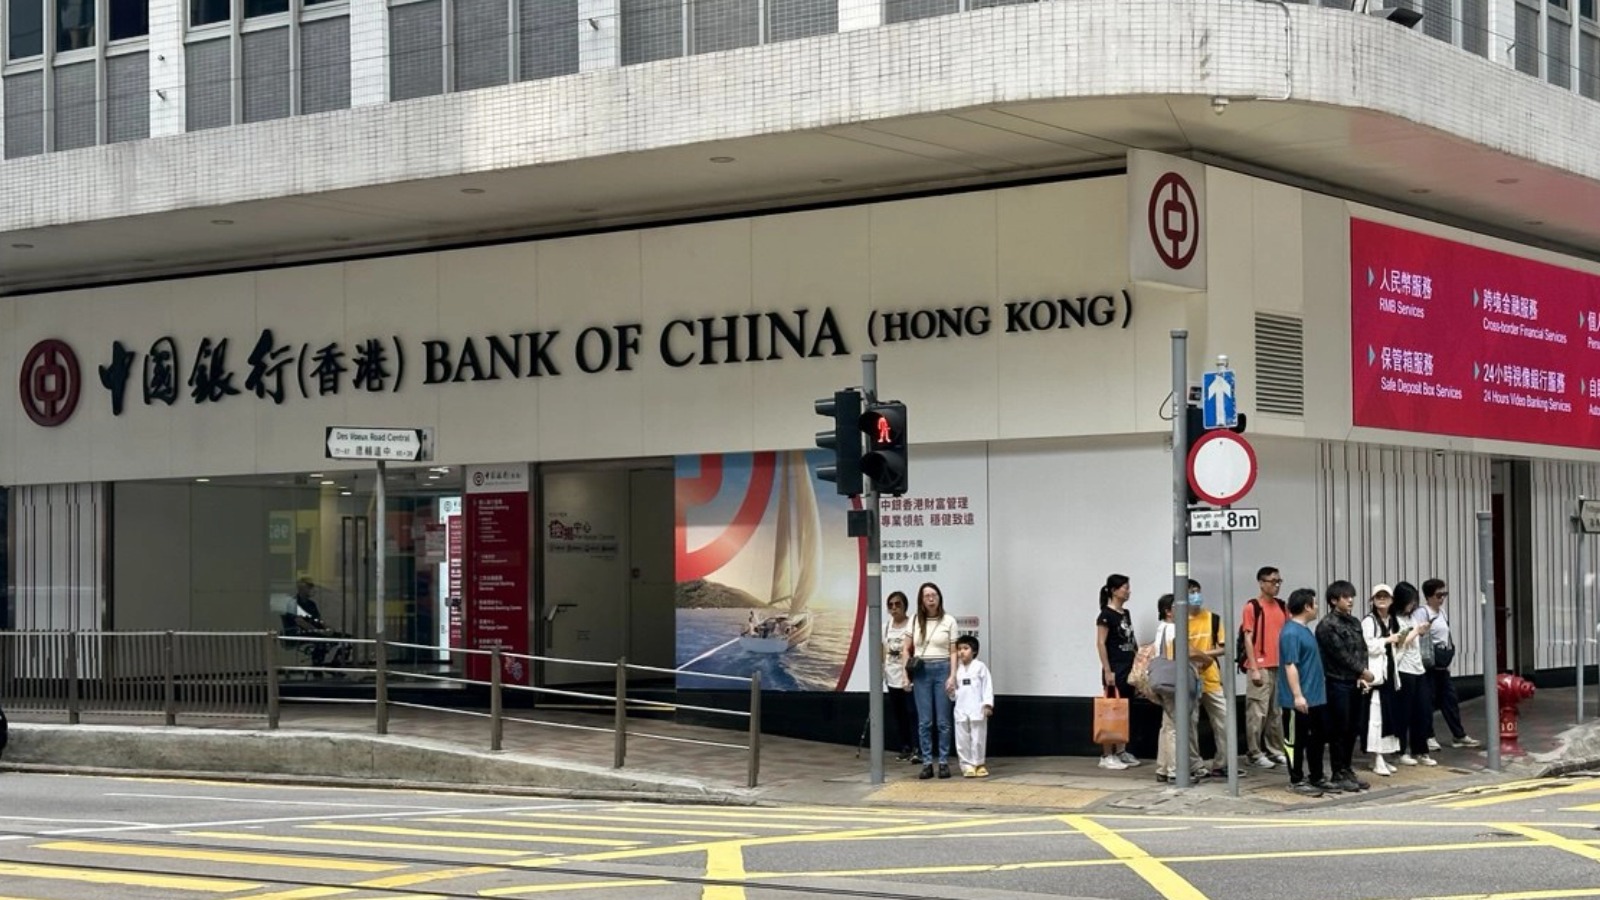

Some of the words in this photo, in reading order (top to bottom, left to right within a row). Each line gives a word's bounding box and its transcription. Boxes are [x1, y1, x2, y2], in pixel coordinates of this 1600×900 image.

[1379, 267, 1433, 300] 人民幣服務
[1379, 297, 1396, 313] RMB
[1397, 300, 1425, 319] Services
[1483, 288, 1538, 320] 跨境金融服務
[422, 330, 561, 385] BANK
[575, 323, 643, 375] OF
[659, 306, 851, 368] CHINA
[867, 306, 992, 347] (HONG
[1004, 289, 1133, 333] KONG)
[1543, 328, 1567, 344] Services
[1381, 346, 1434, 376] 保管箱服務
[1381, 376, 1397, 391] Safe
[1397, 378, 1422, 396] Deposit
[1422, 382, 1436, 397] Box
[1435, 383, 1463, 400] Services
[1491, 390, 1509, 404] Hours
[1509, 392, 1526, 406] Video
[336, 432, 348, 440] Des
[350, 432, 368, 441] Voeux
[370, 432, 385, 441] Road
[388, 433, 410, 442] Central
[881, 497, 969, 511] 中銀香港財富管理
[881, 515, 924, 527] 專業領航
[1227, 511, 1257, 528] 8m
